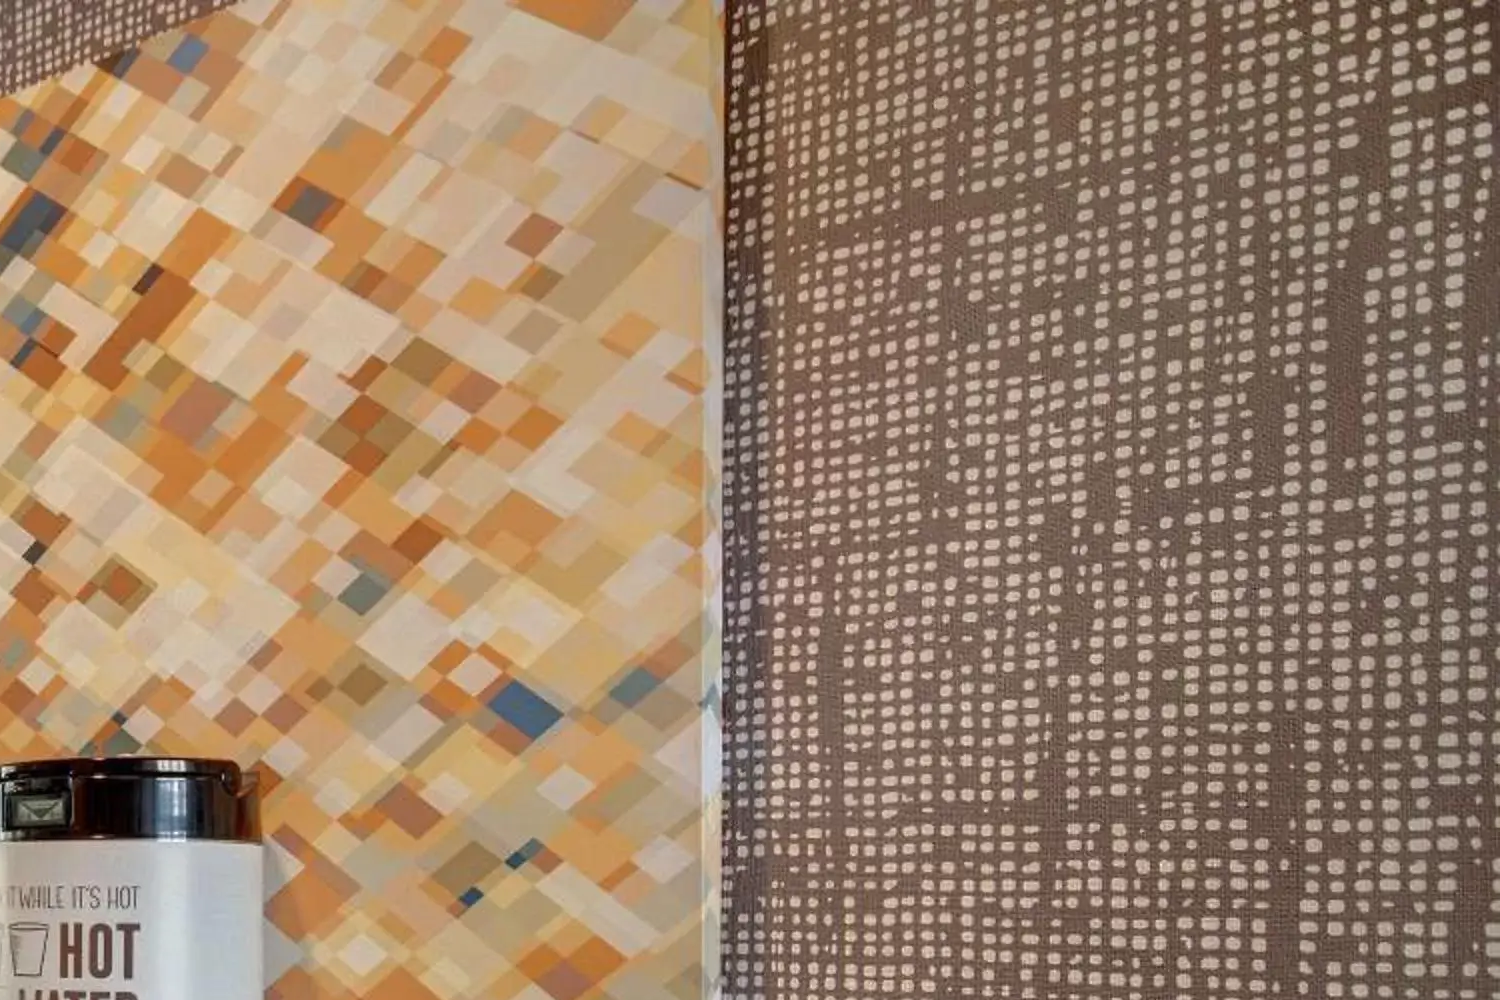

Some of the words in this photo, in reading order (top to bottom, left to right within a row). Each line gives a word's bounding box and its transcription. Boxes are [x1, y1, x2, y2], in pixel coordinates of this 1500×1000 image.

[18, 885, 65, 909] WHILE
[72, 885, 100, 909] IT'S
[107, 885, 141, 909] HOT
[59, 922, 141, 980] HOT
